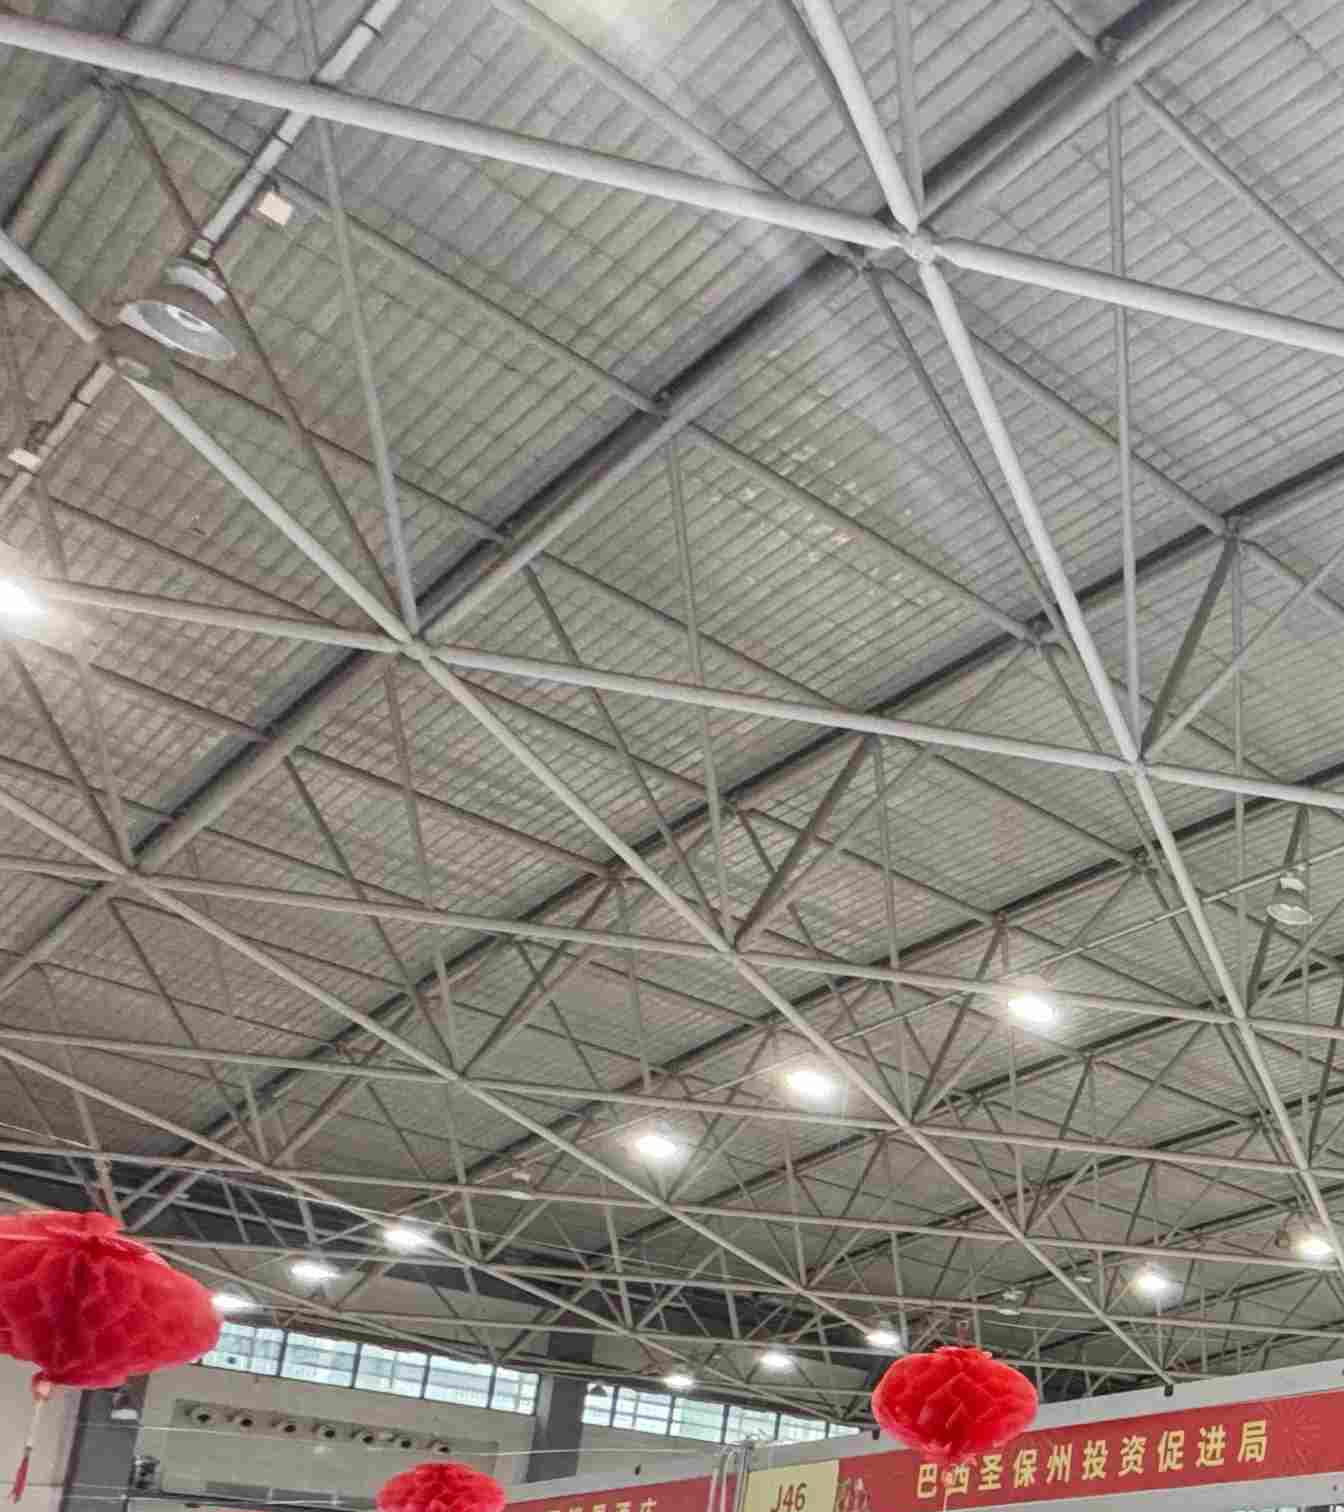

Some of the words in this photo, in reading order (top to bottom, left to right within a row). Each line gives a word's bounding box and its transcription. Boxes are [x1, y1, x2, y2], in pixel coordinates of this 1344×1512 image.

[916, 1418, 1270, 1498] 巴西圣保州投资促进局
